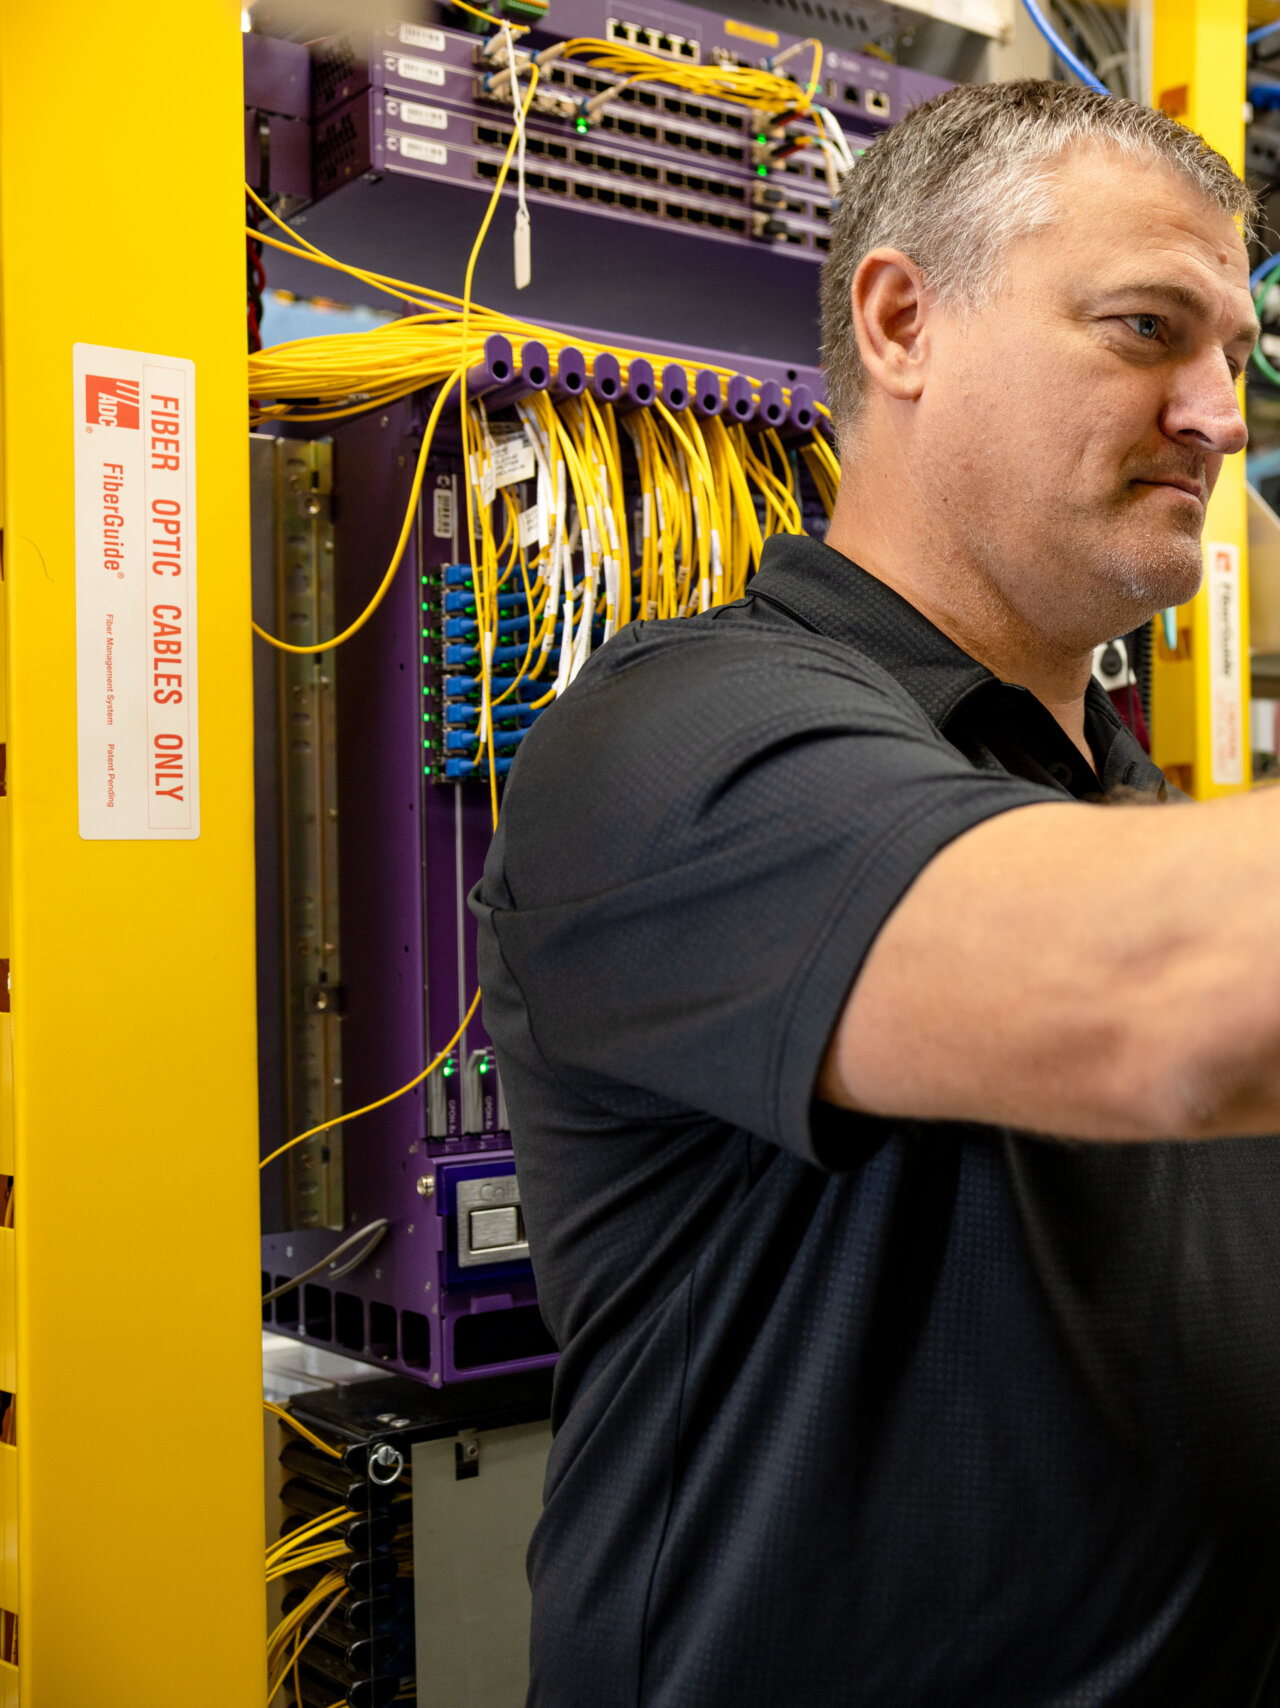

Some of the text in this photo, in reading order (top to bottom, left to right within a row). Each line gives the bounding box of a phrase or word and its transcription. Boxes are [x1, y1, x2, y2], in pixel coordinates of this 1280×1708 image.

[98, 392, 118, 428] ADC
[150, 394, 184, 801] FIBER OPTIC CABLES ONLY
[105, 613, 116, 808] Fiber Management System Patent Pending
[481, 1181, 517, 1201] Cali
